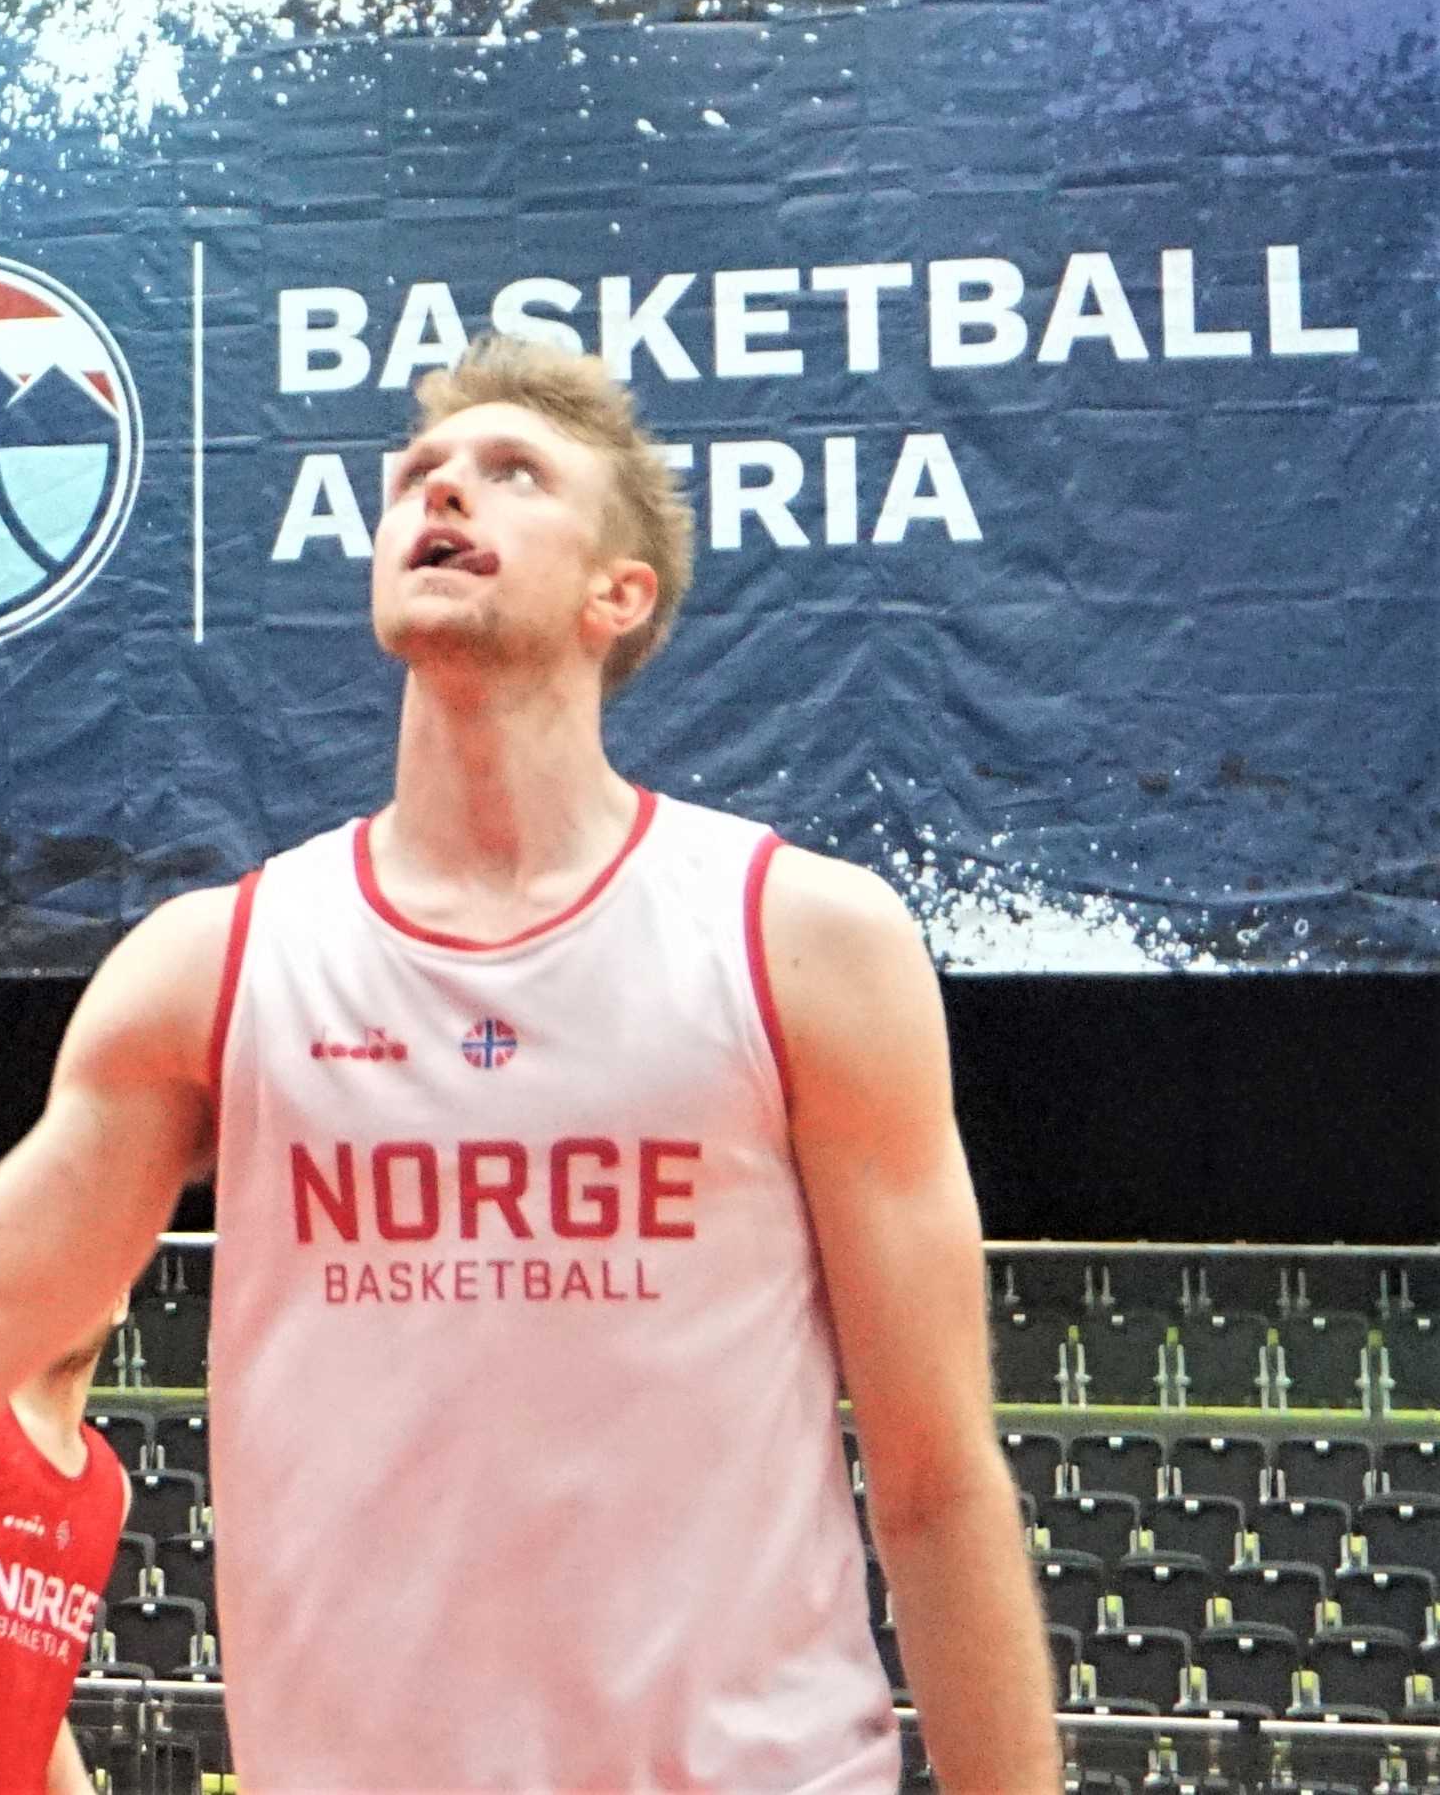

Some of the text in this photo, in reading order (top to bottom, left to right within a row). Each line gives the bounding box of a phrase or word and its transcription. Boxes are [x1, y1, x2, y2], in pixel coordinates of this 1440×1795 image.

[277, 244, 1360, 394] BASKETBALL
[271, 432, 983, 561] ARIA
[289, 1138, 702, 1244] NORGE
[324, 1258, 661, 1303] BASKETBALL
